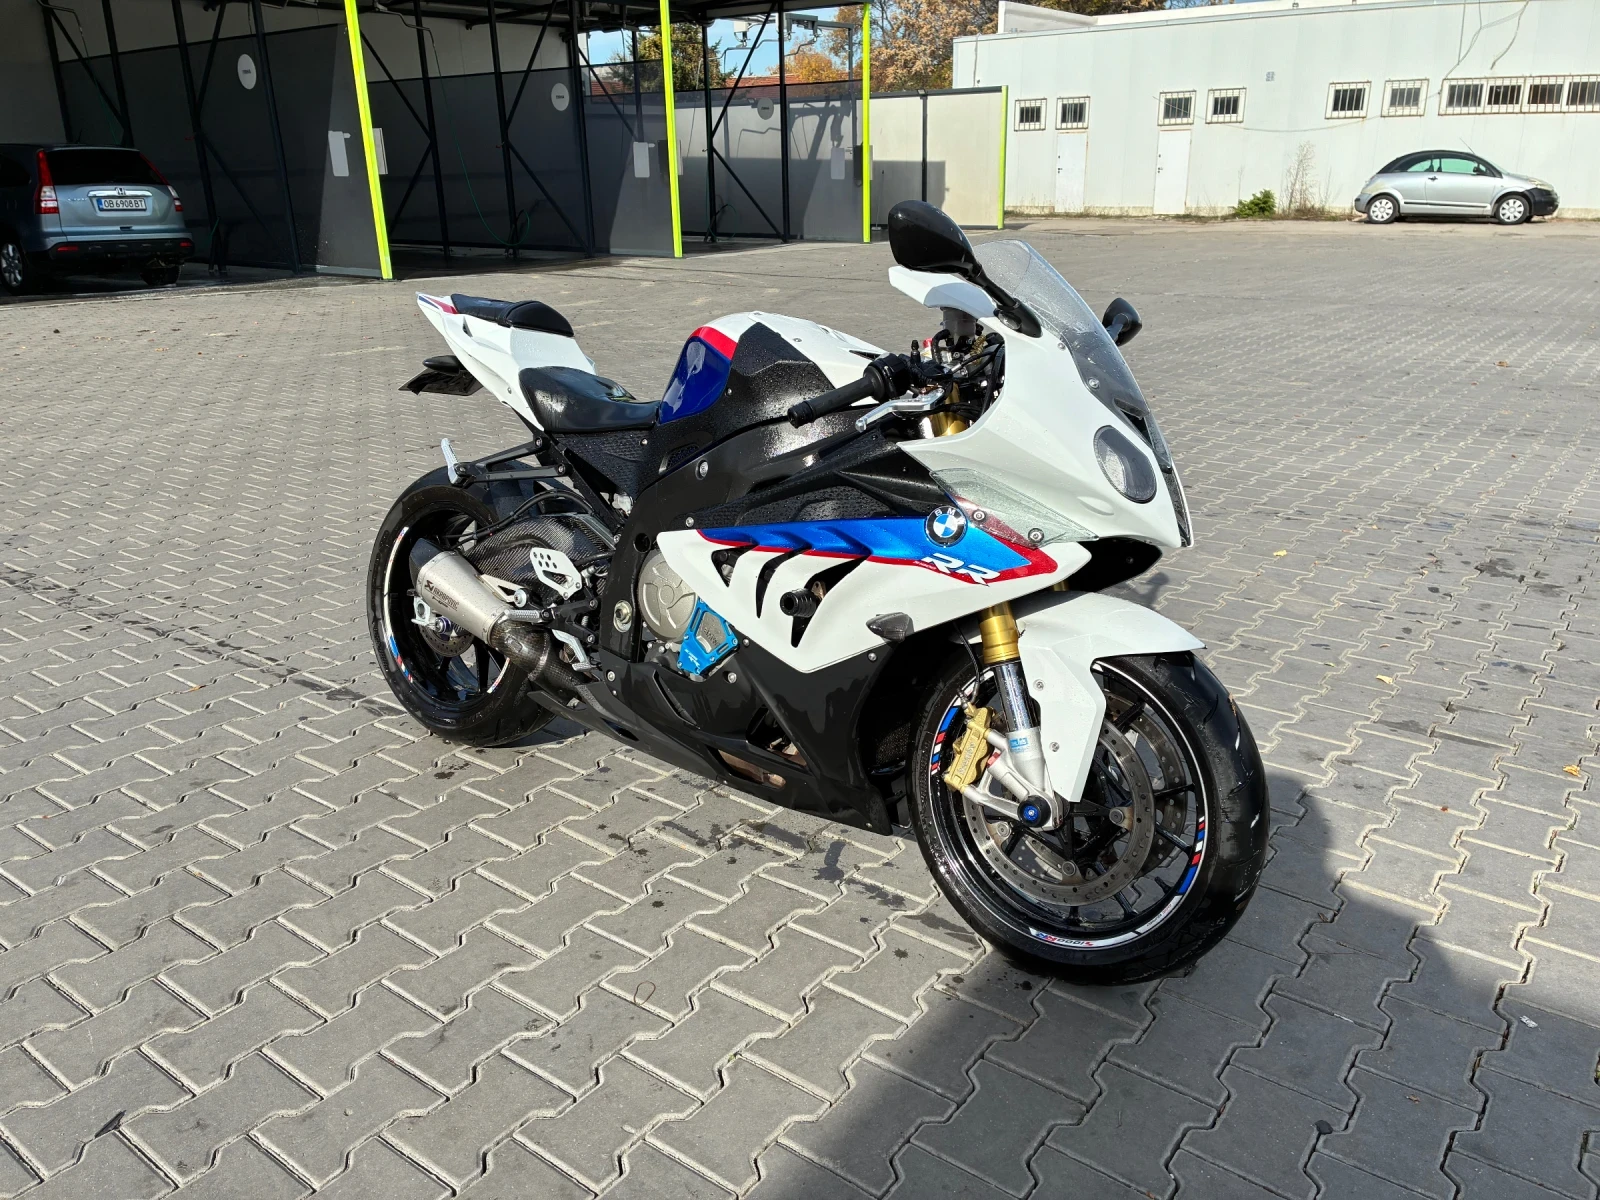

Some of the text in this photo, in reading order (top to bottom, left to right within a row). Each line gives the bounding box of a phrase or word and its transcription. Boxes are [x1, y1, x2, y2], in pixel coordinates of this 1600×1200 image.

[103, 199, 144, 208] OB 6908 BT
